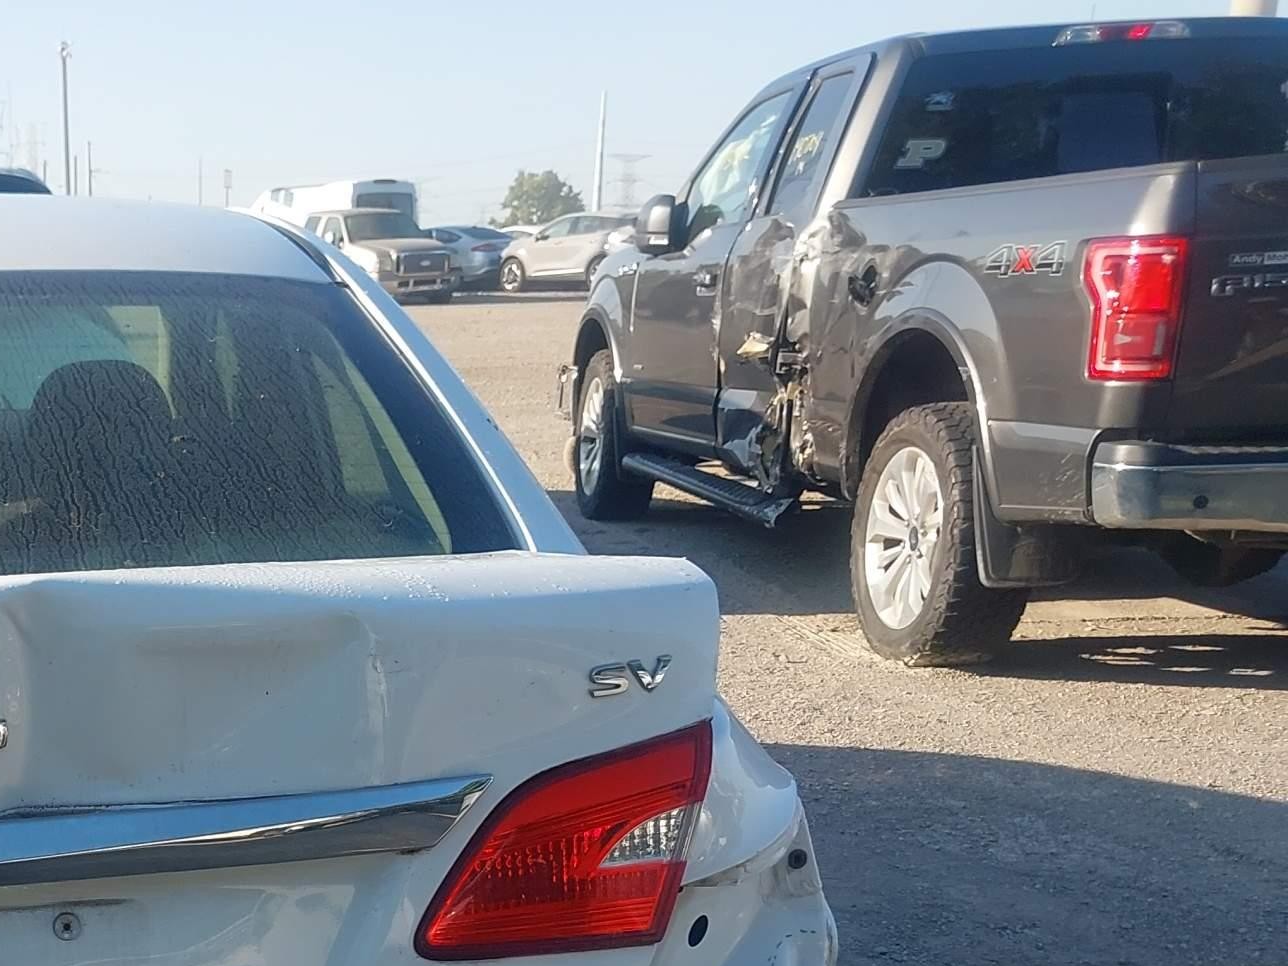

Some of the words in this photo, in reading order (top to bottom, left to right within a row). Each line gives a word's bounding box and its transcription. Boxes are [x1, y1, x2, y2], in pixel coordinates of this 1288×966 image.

[893, 138, 946, 169] P
[1232, 253, 1263, 265] Andy
[588, 654, 673, 698] SV
